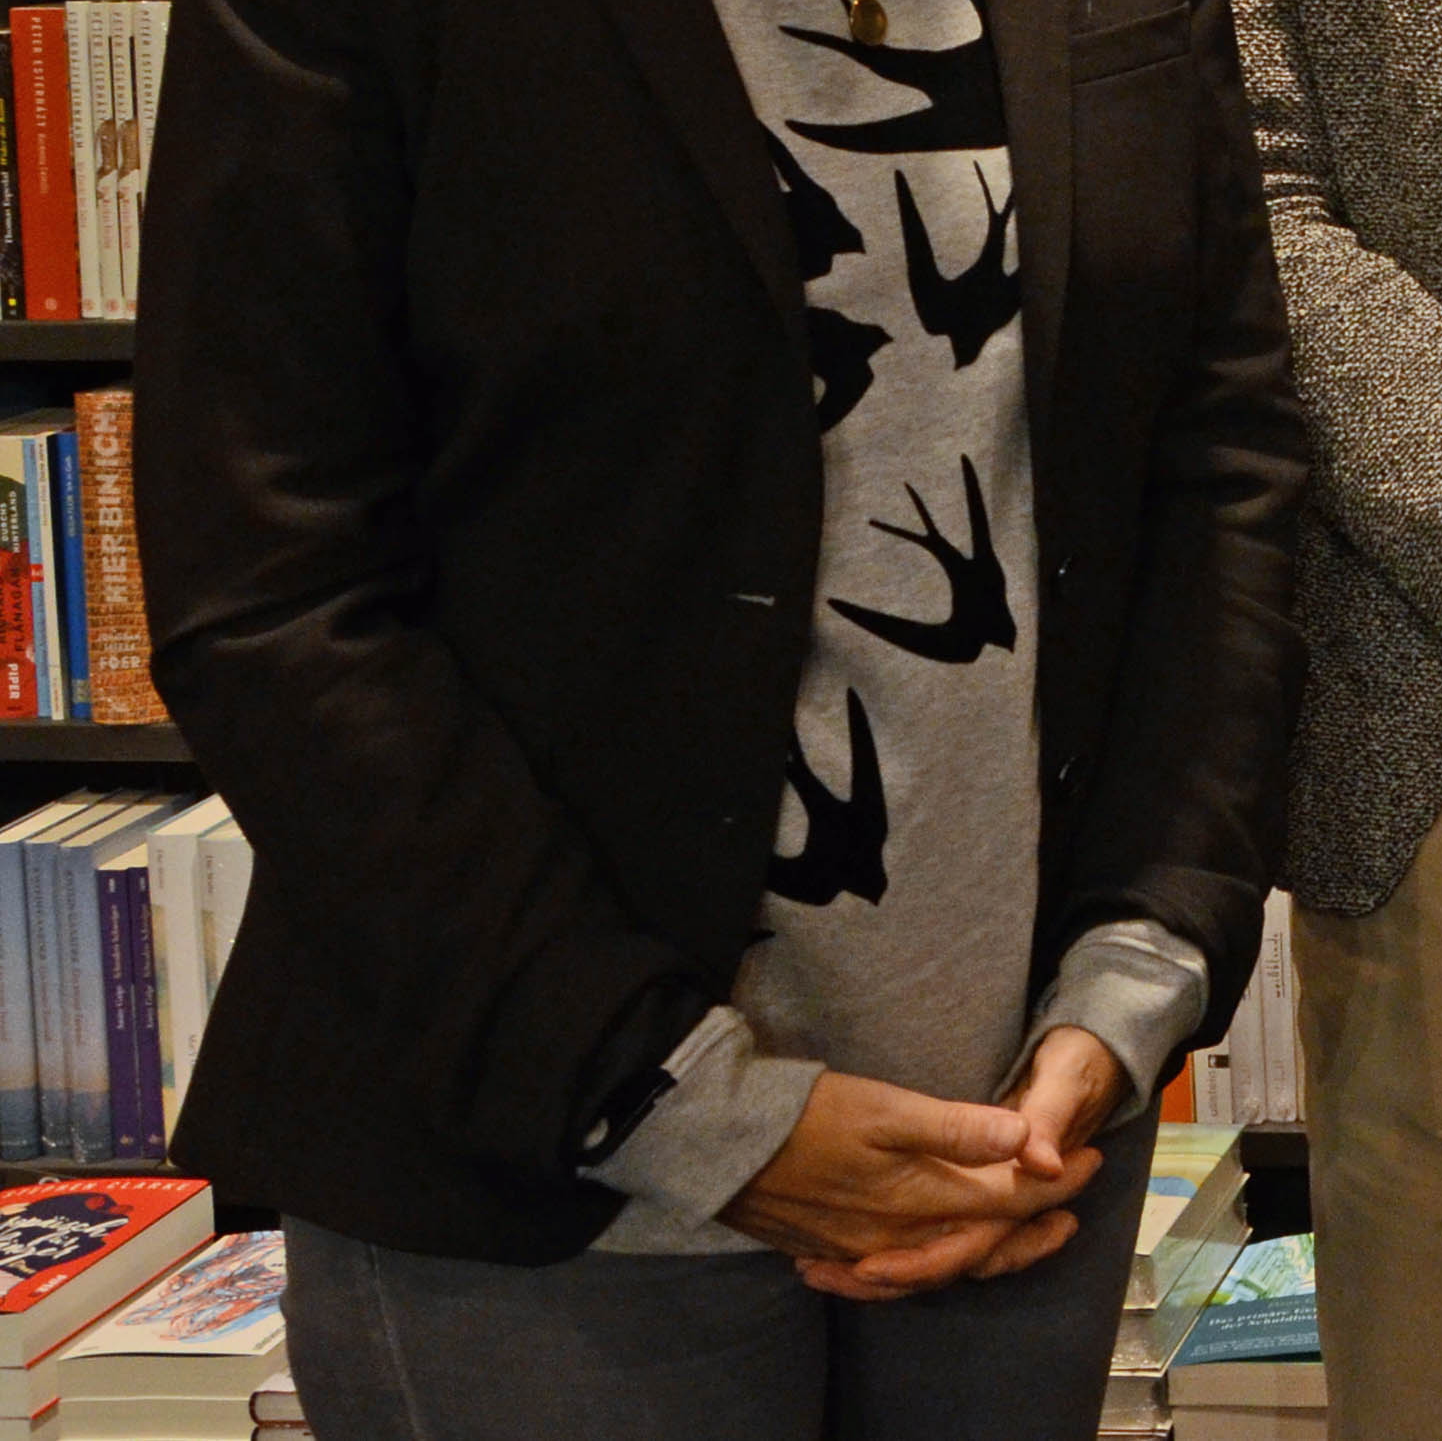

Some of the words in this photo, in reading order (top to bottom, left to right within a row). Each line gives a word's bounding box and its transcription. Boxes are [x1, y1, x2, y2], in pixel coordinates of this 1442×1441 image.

[93, 413, 119, 466] ICH
[8, 490, 20, 553] HINTERLAND
[97, 475, 122, 526] BIN
[102, 534, 127, 602] HIER
[8, 567, 24, 652] FLANAGAN
[9, 663, 20, 699] PIPER
